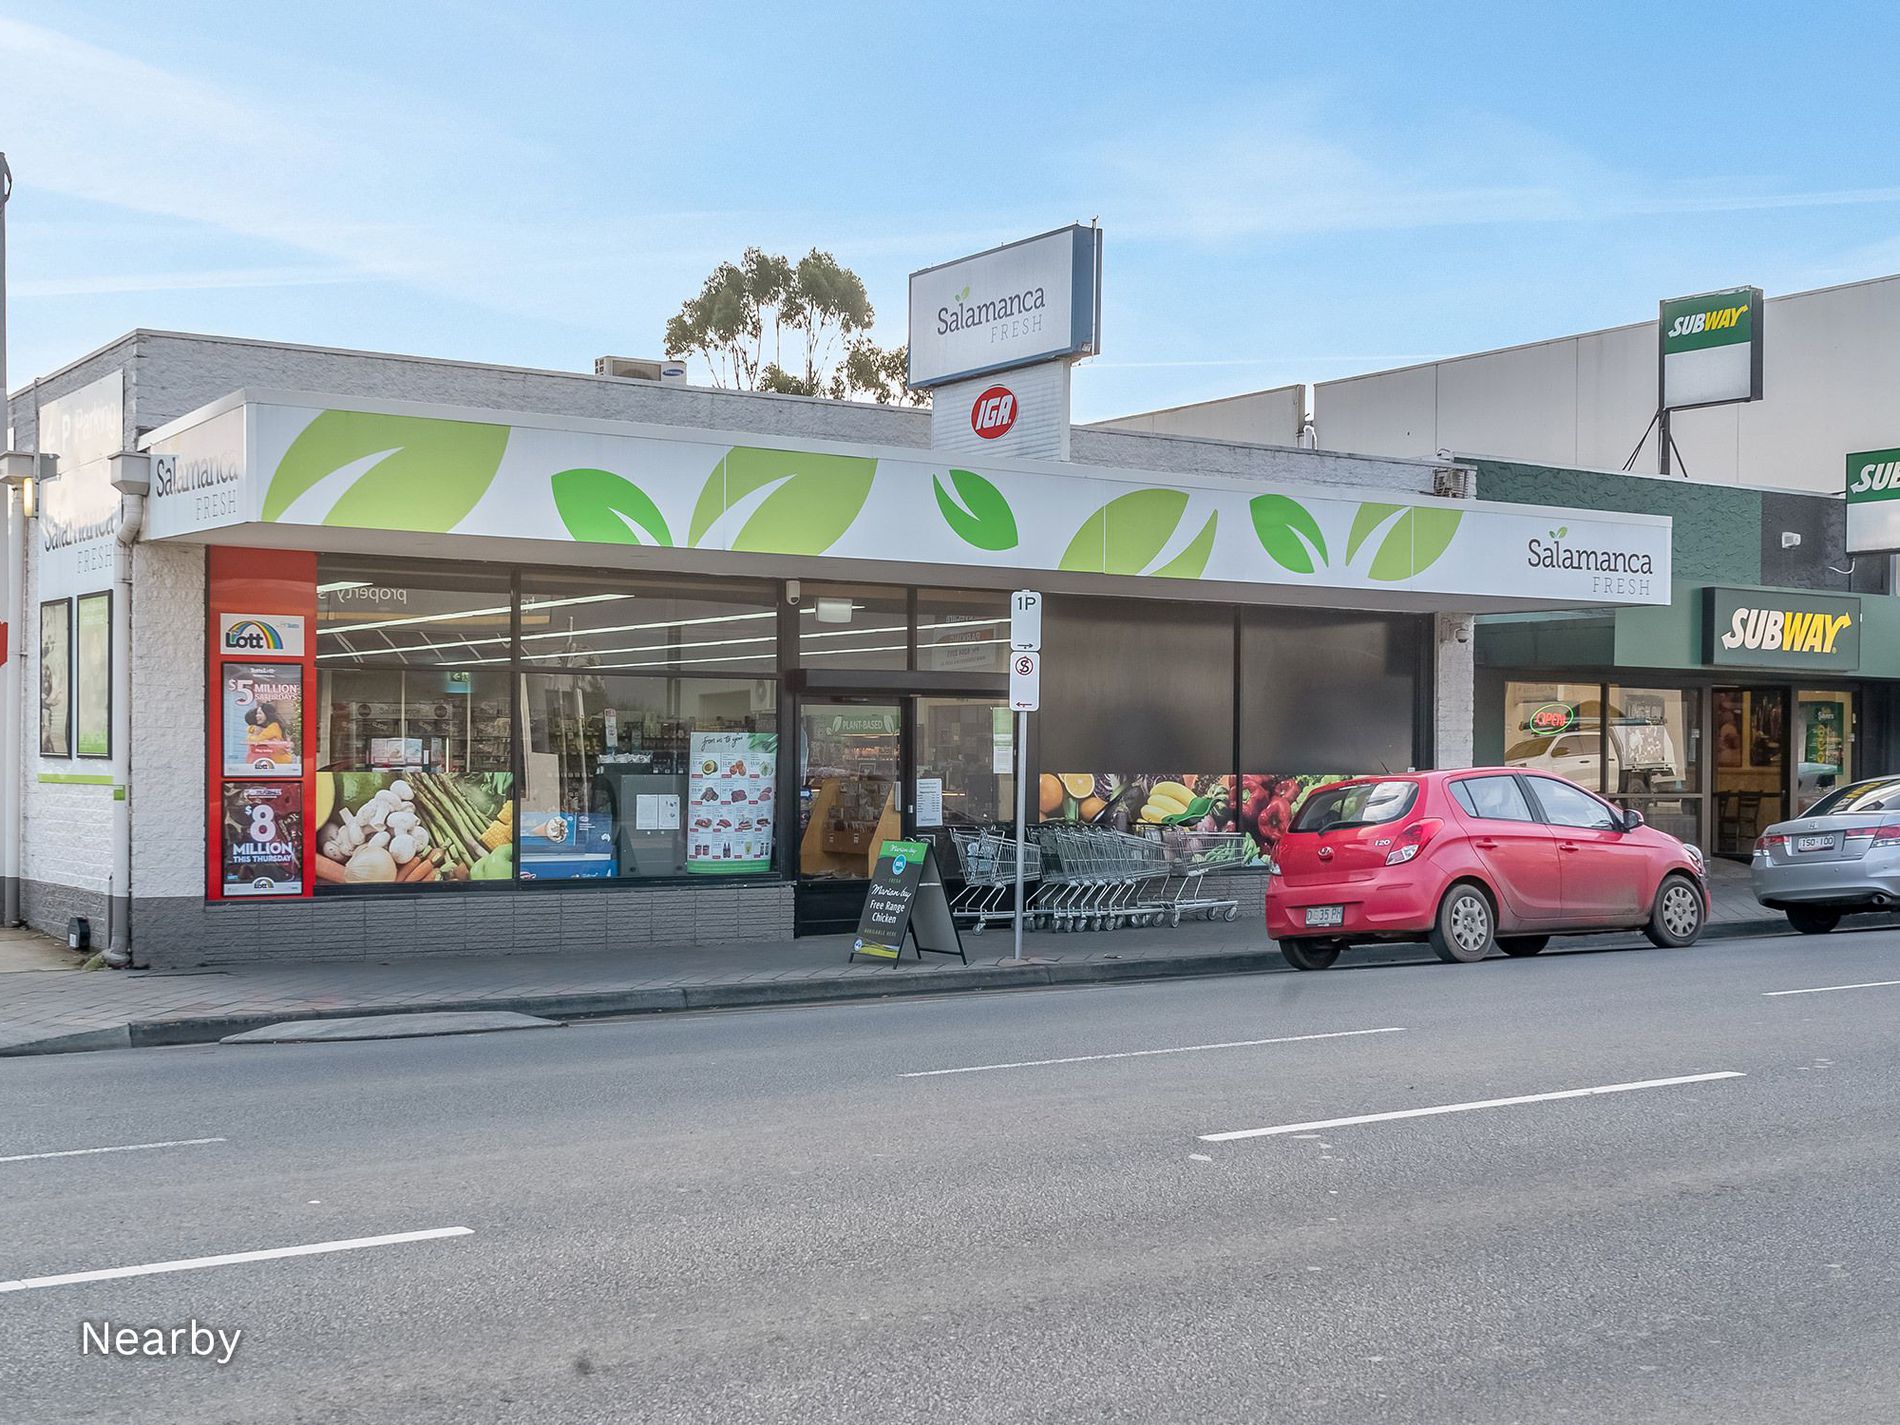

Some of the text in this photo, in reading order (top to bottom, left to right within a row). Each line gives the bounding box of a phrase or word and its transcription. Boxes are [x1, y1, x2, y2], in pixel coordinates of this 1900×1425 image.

[937, 287, 1045, 335] Salamanca
[1668, 304, 1748, 338] SUBWAY
[991, 315, 1043, 343] FRESH
[976, 394, 1013, 430] IGA
[156, 457, 238, 497] Salamanca
[195, 489, 237, 520] FRESH
[77, 543, 113, 573] FRESH
[1528, 538, 1653, 574] Salamanca
[1592, 576, 1651, 596] FRESH
[1017, 596, 1036, 610] 1P
[225, 632, 264, 649] Lott
[1721, 606, 1852, 654] SUBWAY
[228, 678, 298, 706] $5 MILLION
[842, 719, 883, 730] PLANT-BASED
[1536, 711, 1567, 727] OPEN
[245, 804, 277, 843] $8
[233, 843, 293, 855] MILLION
[233, 855, 293, 863] THIS THURSDAY
[871, 883, 900, 897] Marion
[869, 899, 905, 913] Free Range
[872, 912, 897, 924] Chicken
